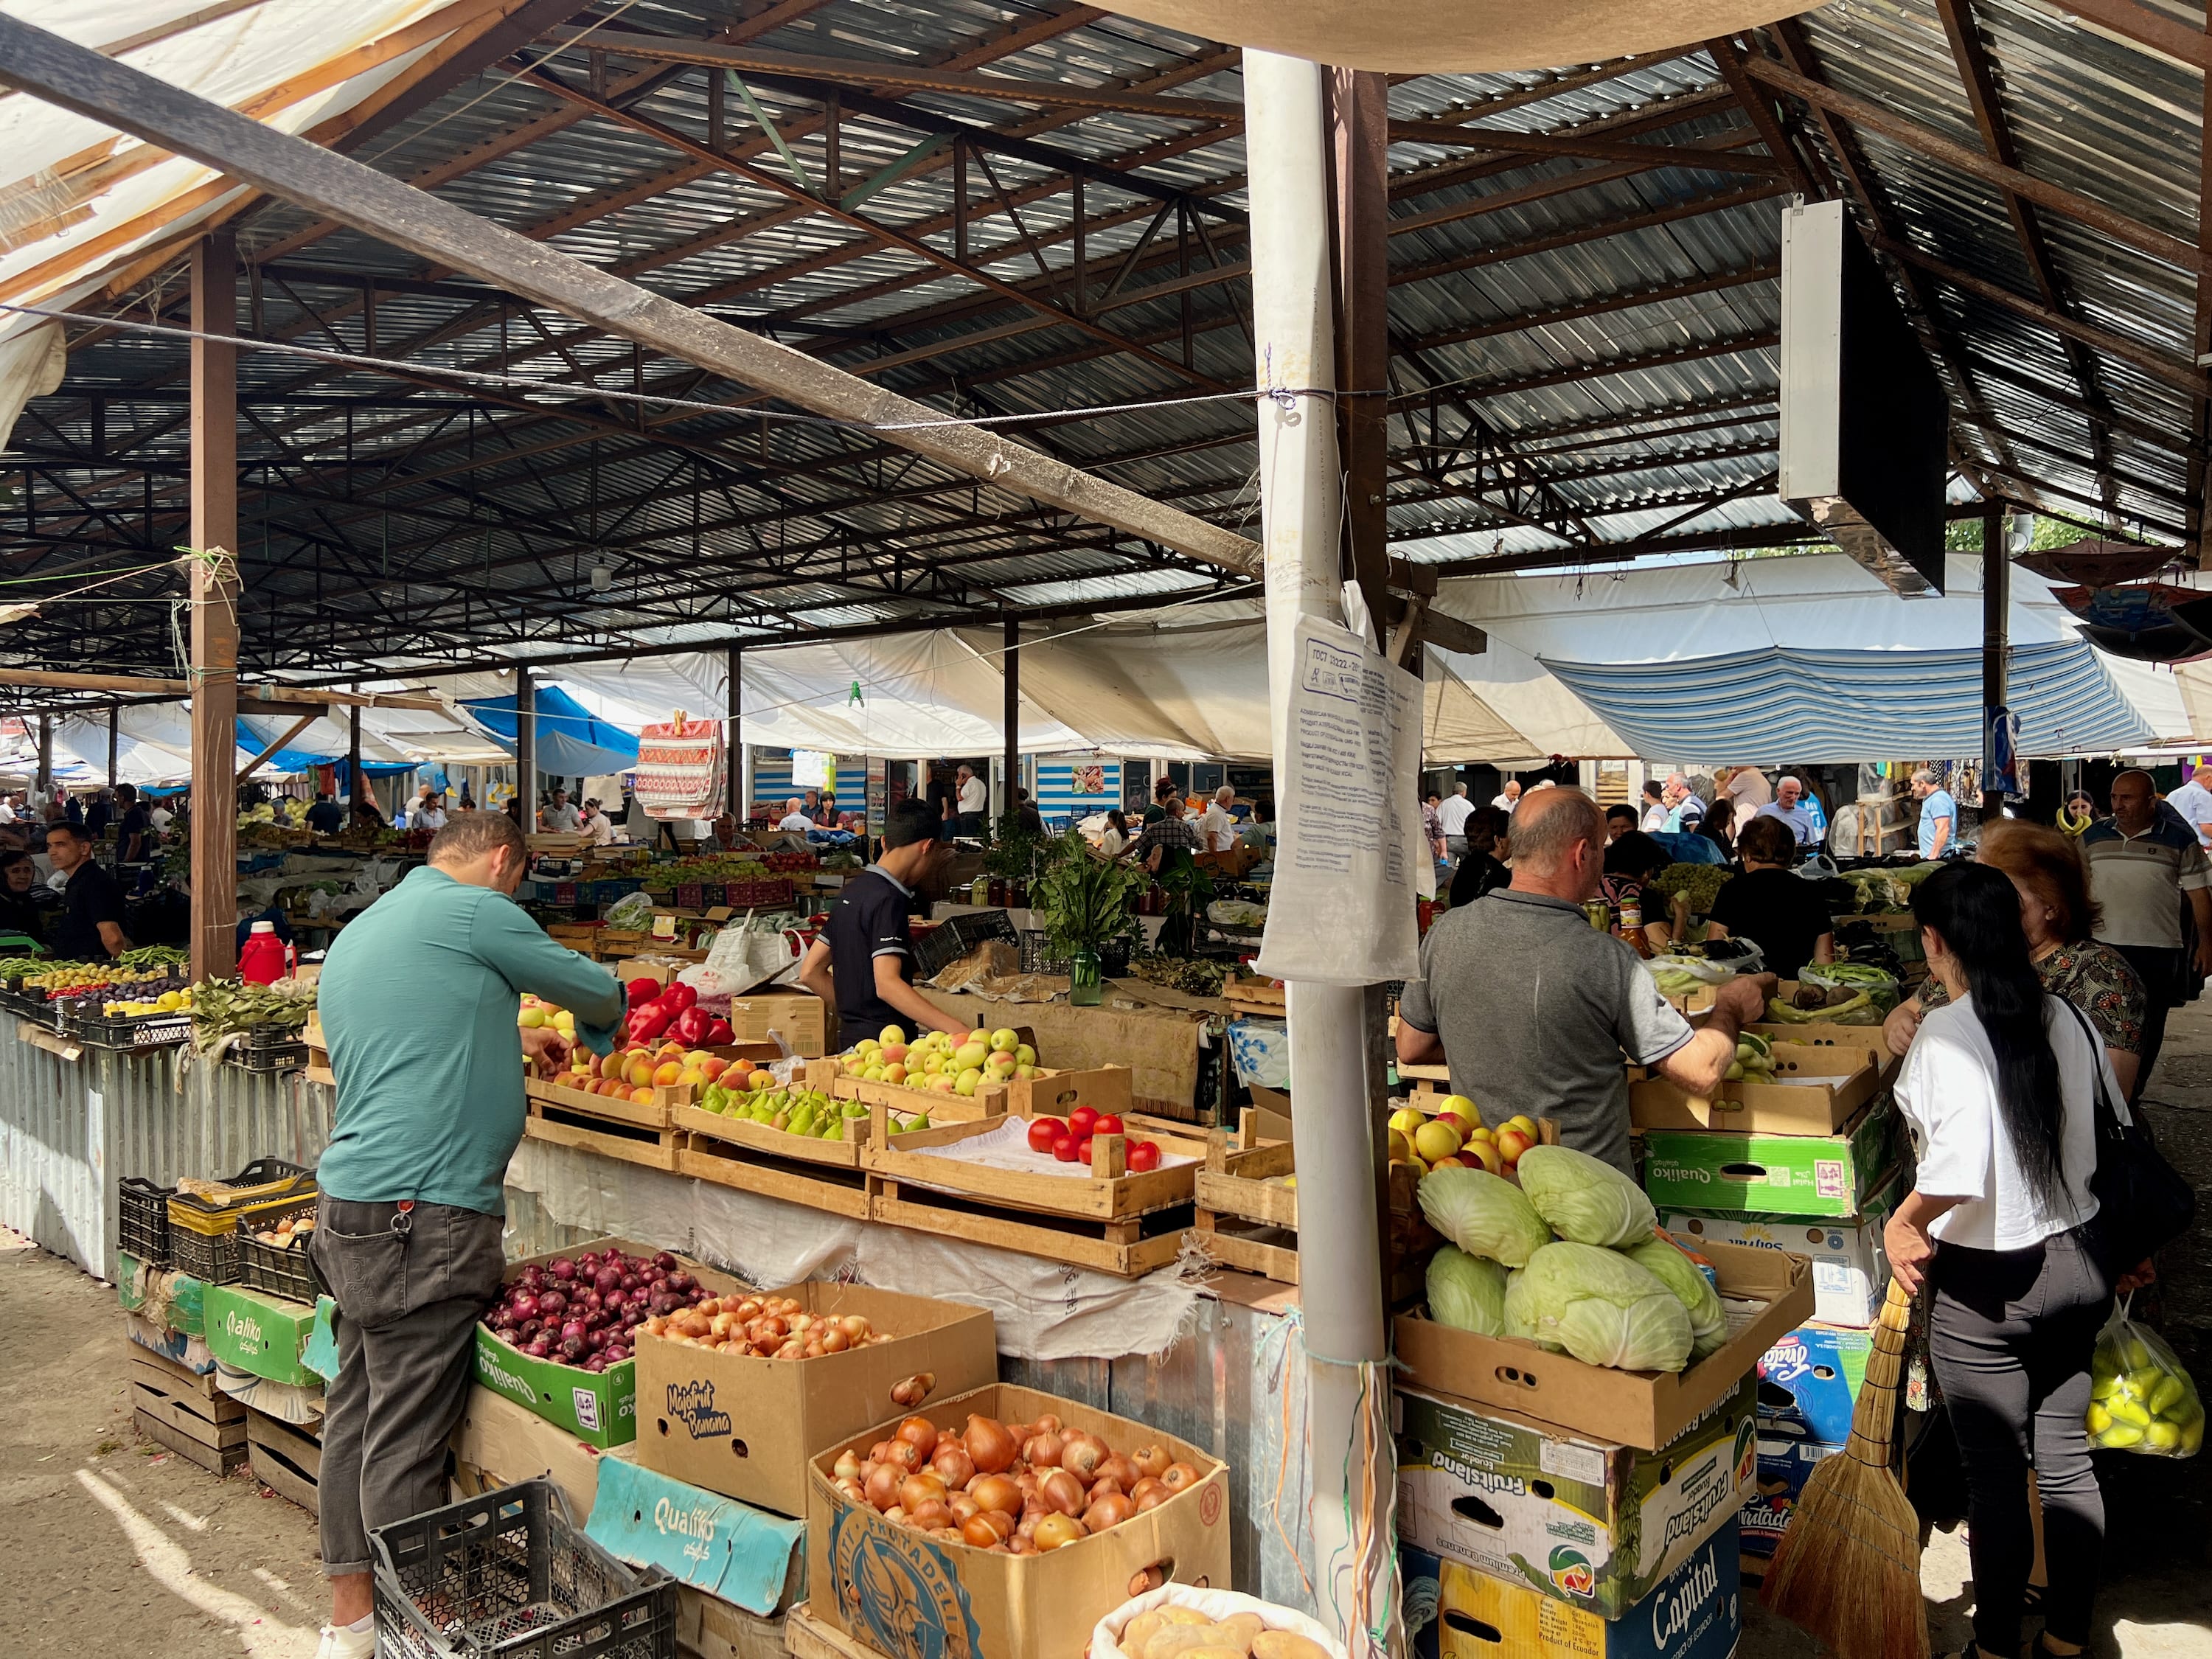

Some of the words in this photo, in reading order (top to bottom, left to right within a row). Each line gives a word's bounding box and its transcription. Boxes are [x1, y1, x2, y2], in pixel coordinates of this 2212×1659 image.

[1312, 649, 1327, 663] ГОСТ
[1652, 1166, 1711, 1184] Qualiko
[1793, 1178, 1814, 1186] Halal
[479, 1356, 537, 1404] Qualiko
[667, 1381, 714, 1416] Majofrut
[689, 1413, 730, 1438] Banana
[1432, 1451, 1526, 1495] Fruitsland
[1461, 1453, 1494, 1470] Ecuador
[1686, 1475, 1711, 1502] Ecuador
[655, 1497, 714, 1542] Qualiko
[1664, 1470, 1728, 1548] Fruitsland
[1436, 1537, 1479, 1562] Bananas
[1480, 1554, 1526, 1581] Premium
[1653, 1544, 1718, 1650] Capital
[1551, 1615, 1568, 1626] Weight
[1551, 1623, 1568, 1632] Length
[1539, 1632, 1562, 1646] Product
[1564, 1640, 1571, 1649] of
[1573, 1642, 1599, 1657] Ecuador
